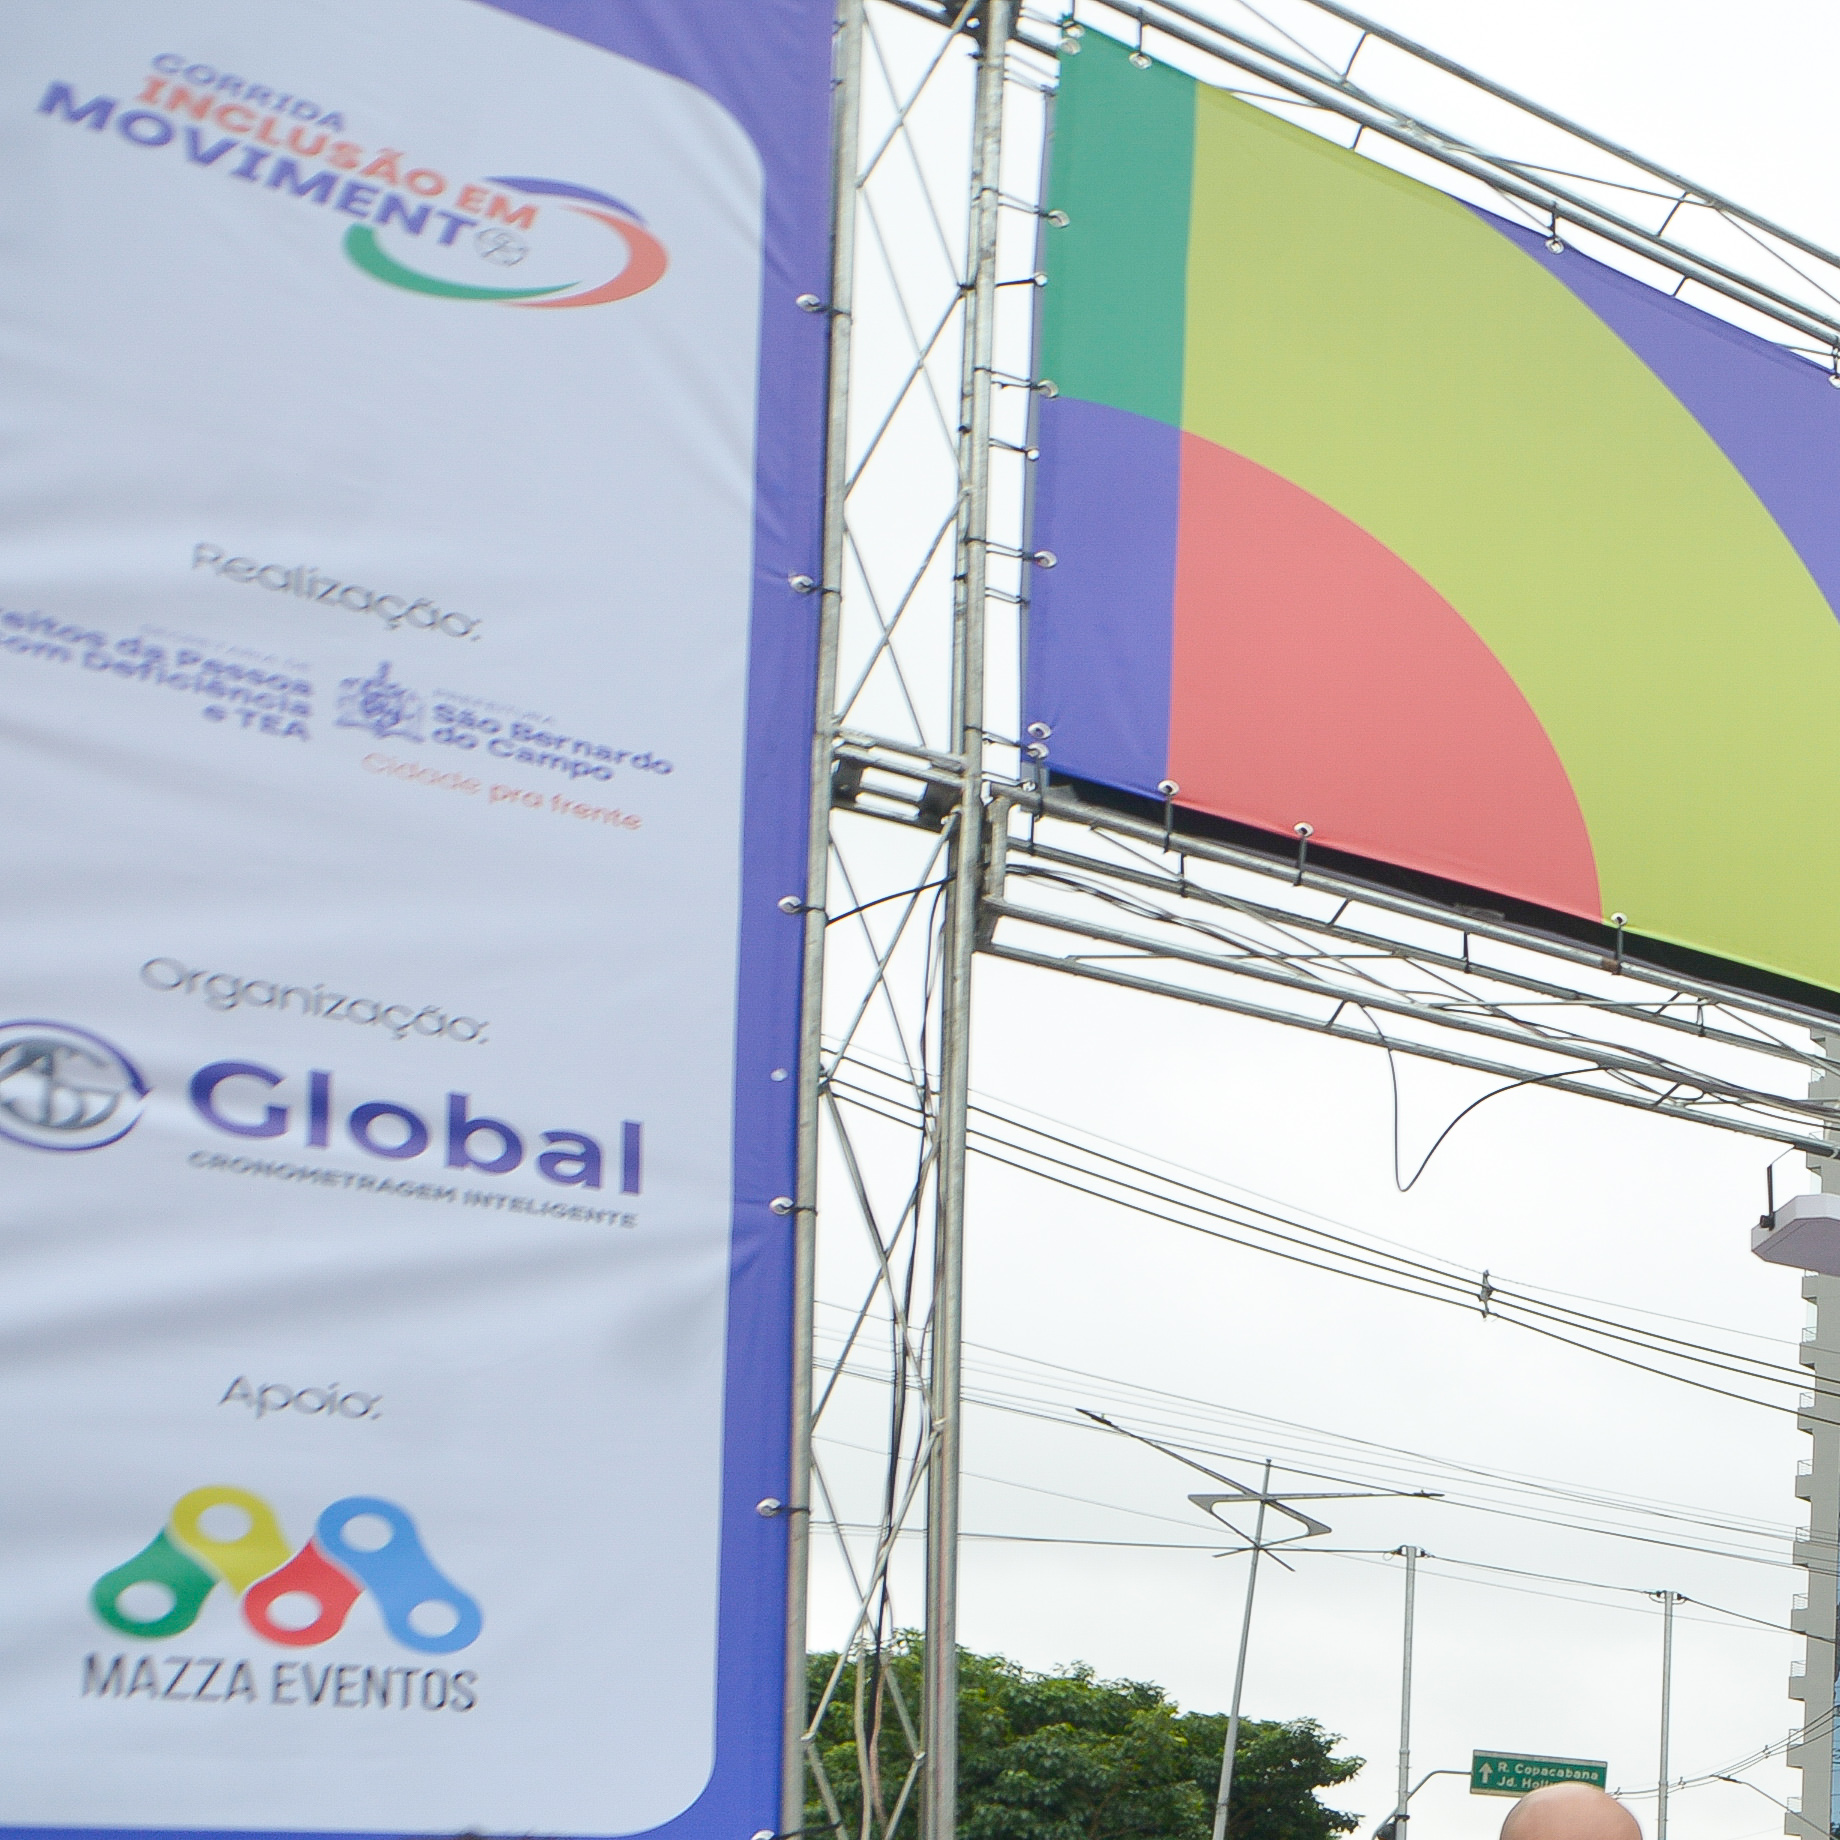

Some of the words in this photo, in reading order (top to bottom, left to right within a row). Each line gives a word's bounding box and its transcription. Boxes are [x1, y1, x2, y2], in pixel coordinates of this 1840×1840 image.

[150, 52, 345, 132] CORRIDA
[136, 74, 447, 199] INCLUSÃO
[454, 184, 539, 230] EM
[192, 541, 482, 641] Realização:
[82, 648, 312, 718] Deficiência
[176, 648, 312, 697] Pessoa
[233, 706, 310, 742] TEA
[432, 701, 501, 735] São
[511, 704, 675, 777] Bernardo
[432, 727, 479, 750] do
[488, 736, 614, 782] Campo
[362, 750, 481, 796] Cidade
[489, 781, 545, 809] pra
[550, 790, 644, 833] frente
[140, 956, 490, 1045] Organização:
[189, 1060, 645, 1197] Global
[188, 1149, 457, 1206] CRONOMETRAGEM
[462, 1188, 639, 1231] INTELIGENTE
[217, 1375, 384, 1421] Apoio:
[82, 1652, 258, 1703] MAZZA
[273, 1661, 480, 1714] EVENTOS
[1515, 1763, 1599, 1780] Copacabana
